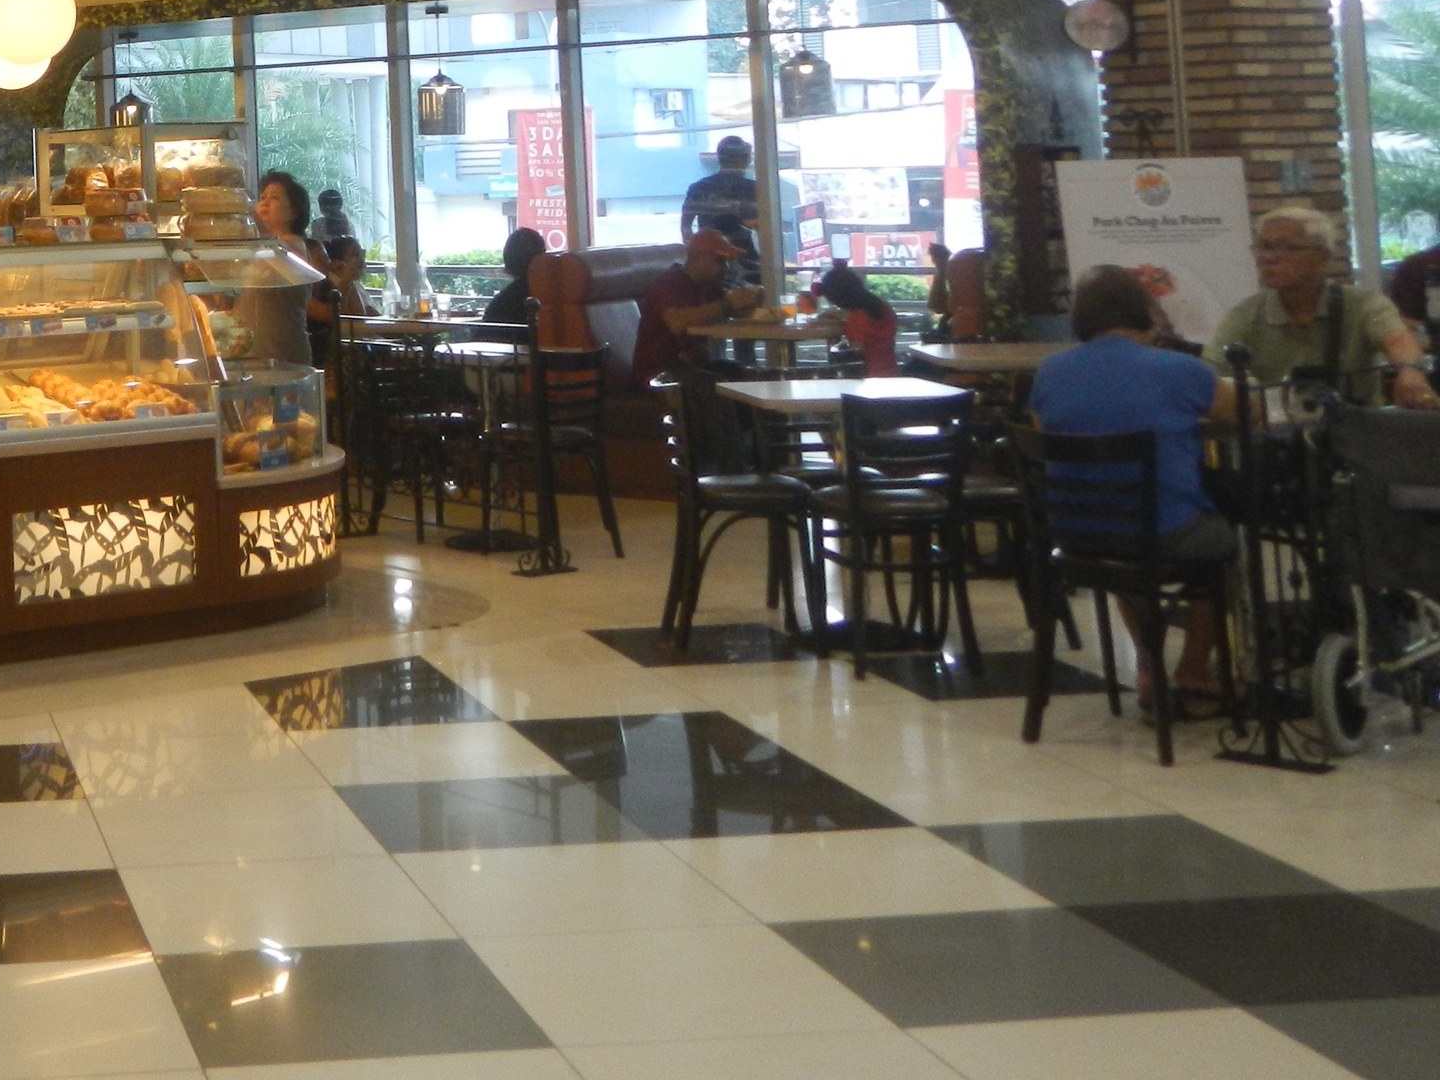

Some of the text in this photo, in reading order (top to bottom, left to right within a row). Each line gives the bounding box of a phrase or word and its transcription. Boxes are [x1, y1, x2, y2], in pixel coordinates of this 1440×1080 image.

[528, 126, 564, 141] 3 DA
[528, 142, 564, 157] SAL
[528, 198, 566, 208] PRESTI
[536, 207, 567, 217] FRID
